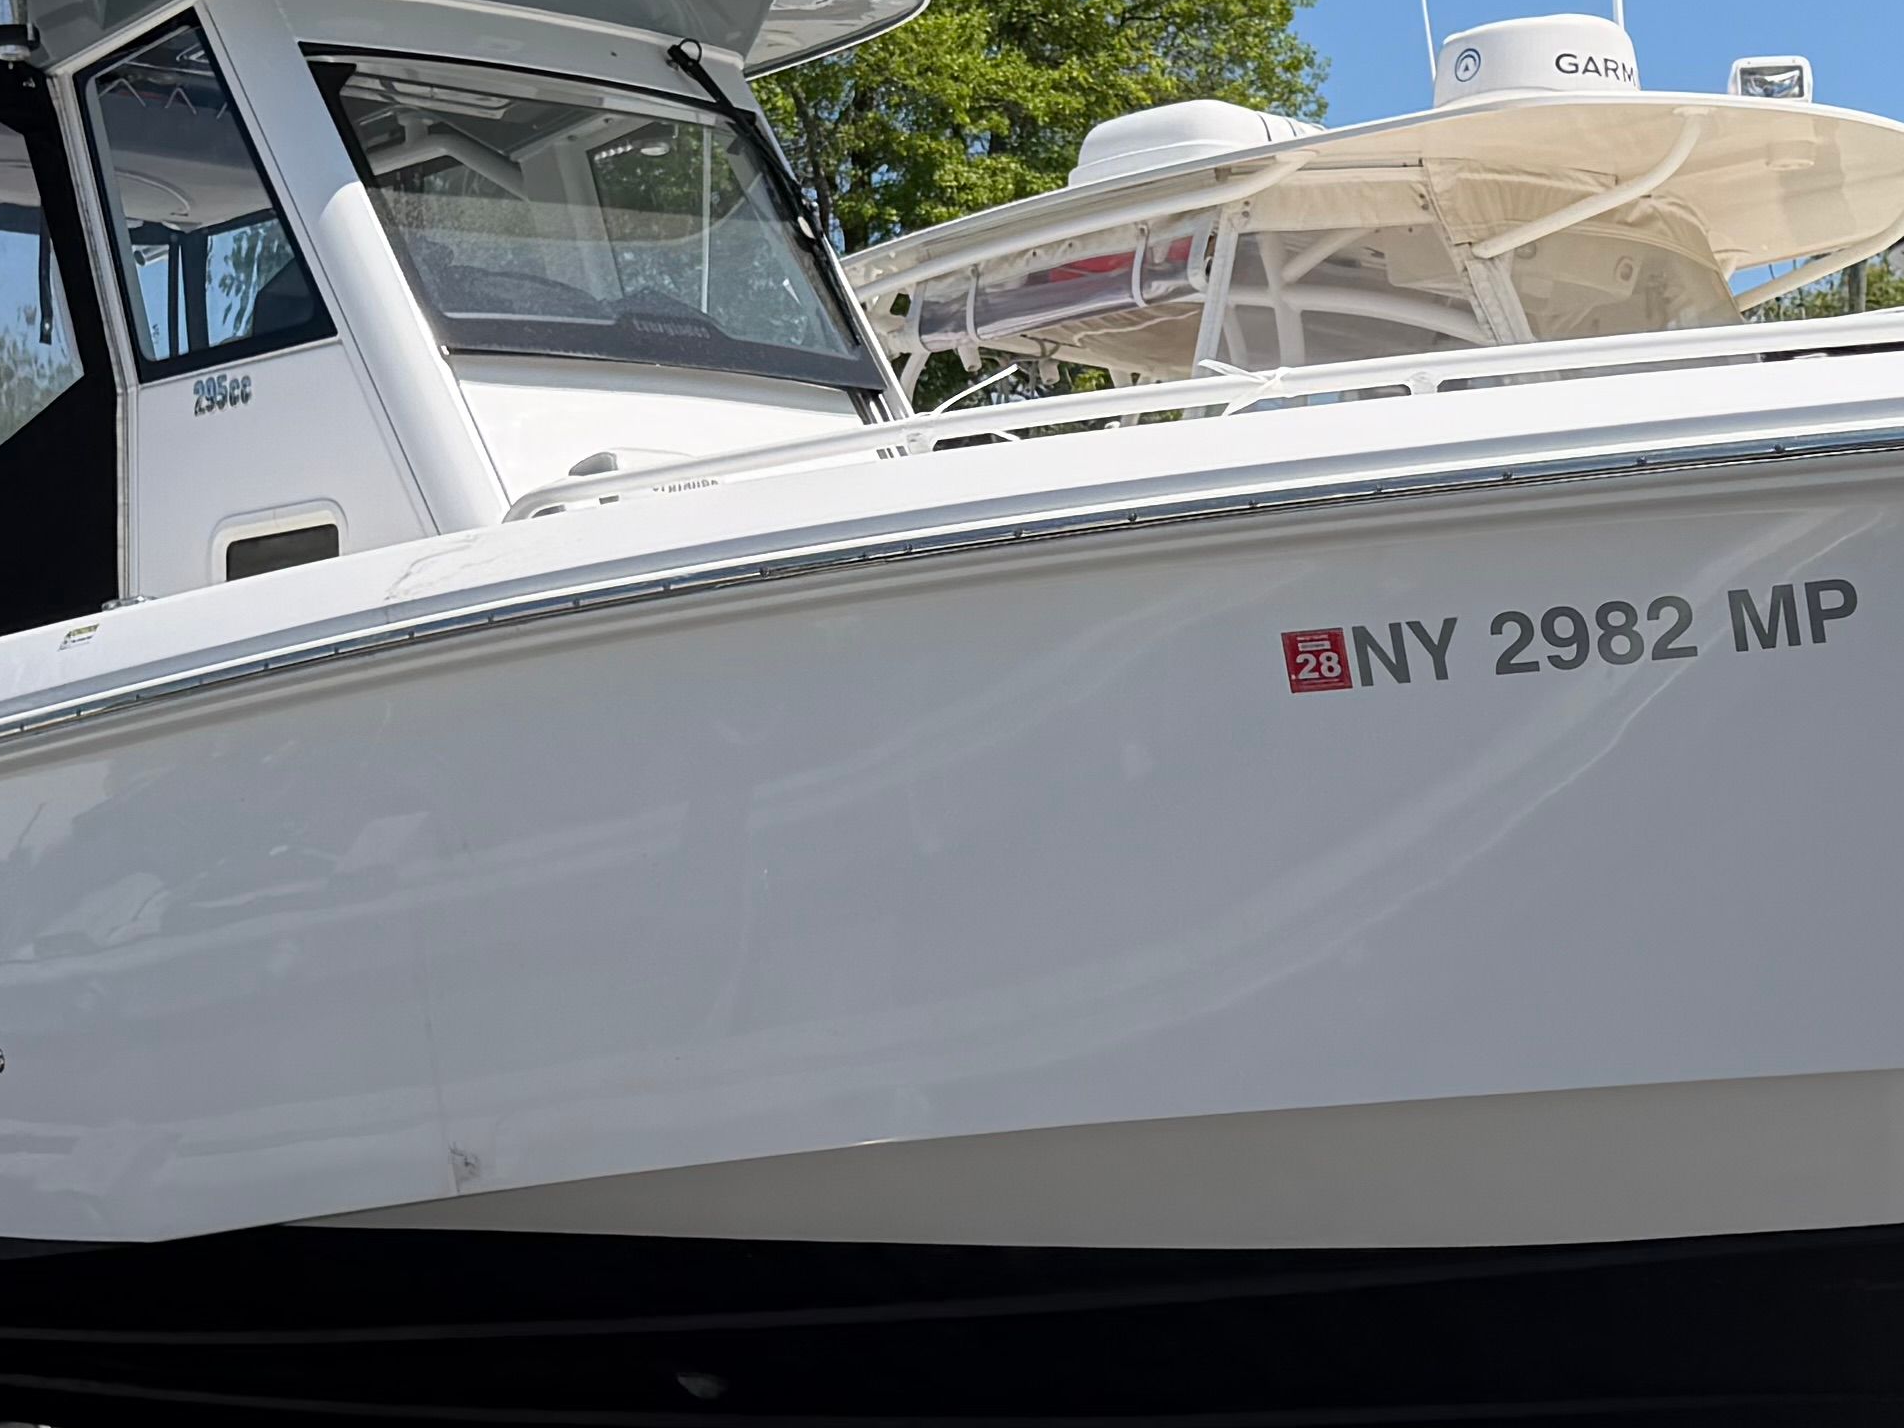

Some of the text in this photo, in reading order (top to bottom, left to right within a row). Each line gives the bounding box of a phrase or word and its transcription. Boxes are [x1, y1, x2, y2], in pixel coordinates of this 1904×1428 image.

[1295, 651, 1342, 679] 28
[1351, 578, 1858, 687] NY 2982 MP
